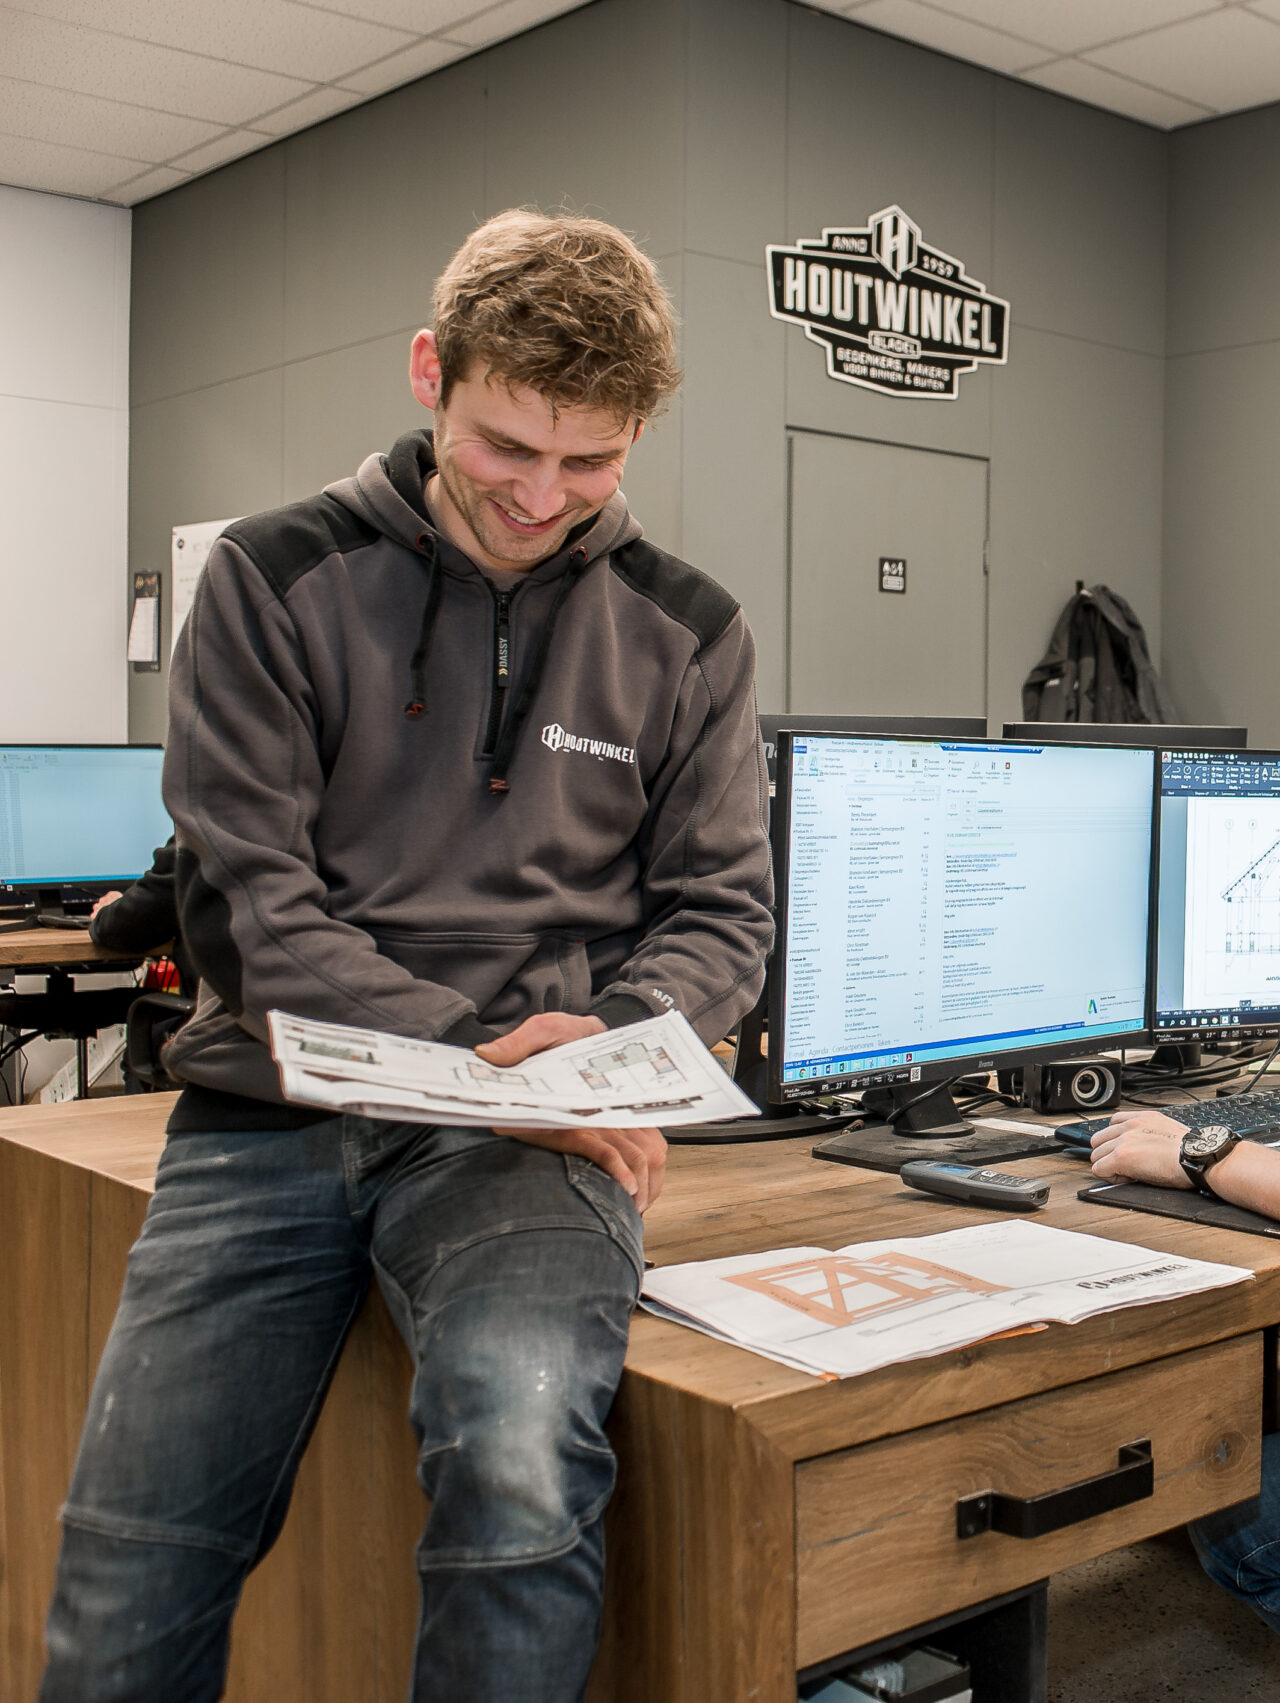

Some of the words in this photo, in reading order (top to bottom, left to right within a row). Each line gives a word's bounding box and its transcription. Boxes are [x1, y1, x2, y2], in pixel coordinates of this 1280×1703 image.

[832, 236, 868, 253] ANNO
[922, 255, 955, 278] 1959
[784, 257, 997, 353] HOUTWINKEL
[873, 336, 918, 355] BLADEL
[499, 637, 508, 668] DASSY
[564, 733, 636, 764] HOUTWINKEL
